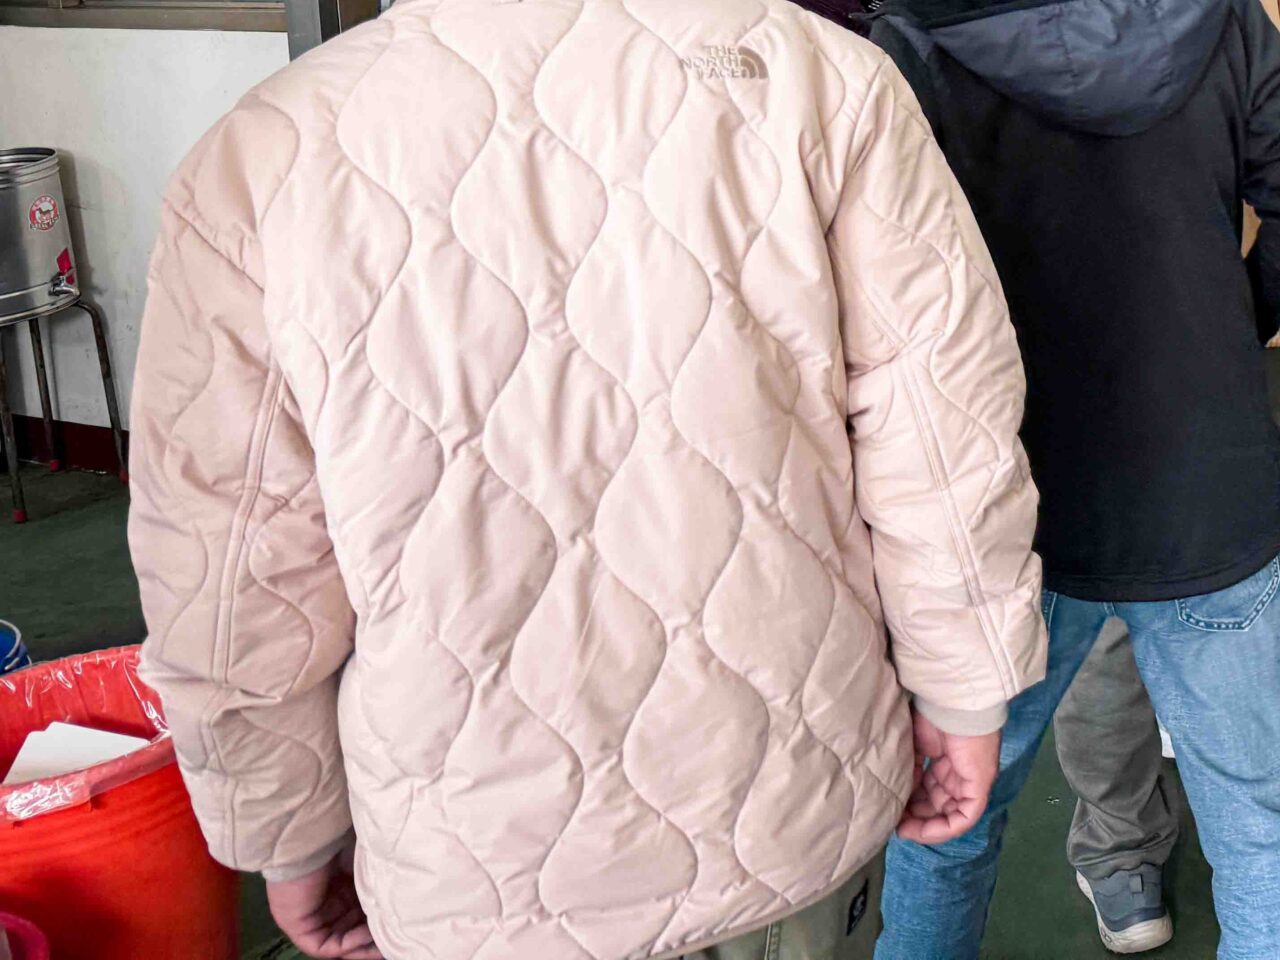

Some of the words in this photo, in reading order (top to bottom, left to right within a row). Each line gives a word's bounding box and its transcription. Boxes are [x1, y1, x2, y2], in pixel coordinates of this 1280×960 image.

[703, 45, 738, 56] THE
[680, 56, 741, 70] NORTH
[697, 67, 742, 80] FACE
